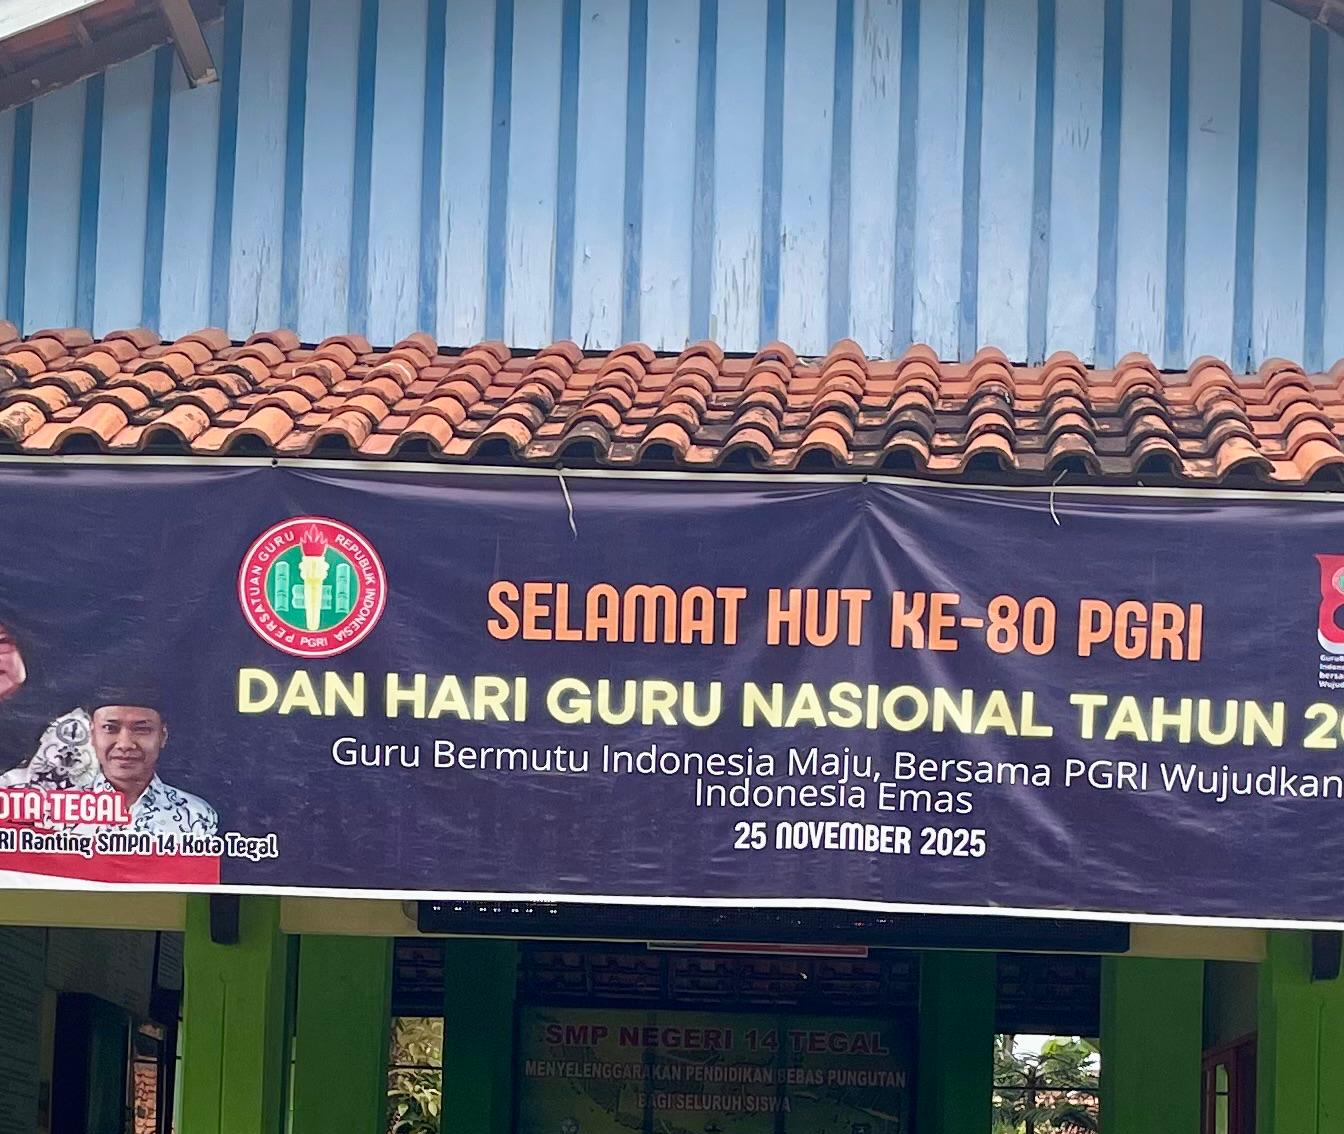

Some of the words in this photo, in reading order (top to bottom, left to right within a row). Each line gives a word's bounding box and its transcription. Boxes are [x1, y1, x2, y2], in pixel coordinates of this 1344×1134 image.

[258, 530, 295, 562] GURU
[335, 534, 376, 585] REPUBLIK
[249, 566, 295, 643] PERSATUAN
[334, 588, 377, 642] INDONESIA
[487, 581, 746, 645] SELAMAT
[767, 588, 871, 647] HUT
[891, 591, 1057, 656] KE-80
[1078, 599, 1204, 663] PGRI
[300, 636, 328, 648] PGRI
[238, 668, 364, 717] DAN
[386, 673, 527, 722] HARI
[547, 678, 721, 726] GURU
[742, 682, 1054, 738] NASIONAL
[1069, 694, 1285, 747] TAHUN
[332, 737, 420, 768] Guru
[433, 740, 589, 773] Bermutu
[602, 744, 775, 776] Indonesia
[789, 746, 881, 783] Maju,
[894, 751, 1052, 787] Bersama
[1064, 759, 1149, 791] PGRI
[1160, 760, 1344, 802] Wujudkan
[51, 793, 129, 822] TEGAL
[695, 778, 865, 808] Indonesia
[879, 782, 973, 814] Emas
[22, 831, 92, 854] Ranting
[97, 833, 150, 853] SMPN
[158, 834, 176, 853] 14
[182, 835, 221, 854] Kota
[228, 835, 278, 859] Tegal
[734, 821, 767, 849] 25
[775, 821, 911, 854] NOVEMBER
[920, 827, 986, 857] 2025
[545, 1023, 610, 1047] SMP
[618, 1025, 735, 1050] NEGERI
[745, 1029, 779, 1053] 14
[787, 1029, 889, 1056] TEGAL
[525, 1060, 682, 1082] MENYELENGGARAKAN
[686, 1064, 773, 1085] PENDIDIKAN
[777, 1067, 825, 1085] BEBAS
[827, 1069, 906, 1090] PUNGUTAN
[675, 1094, 741, 1112] SELURUH
